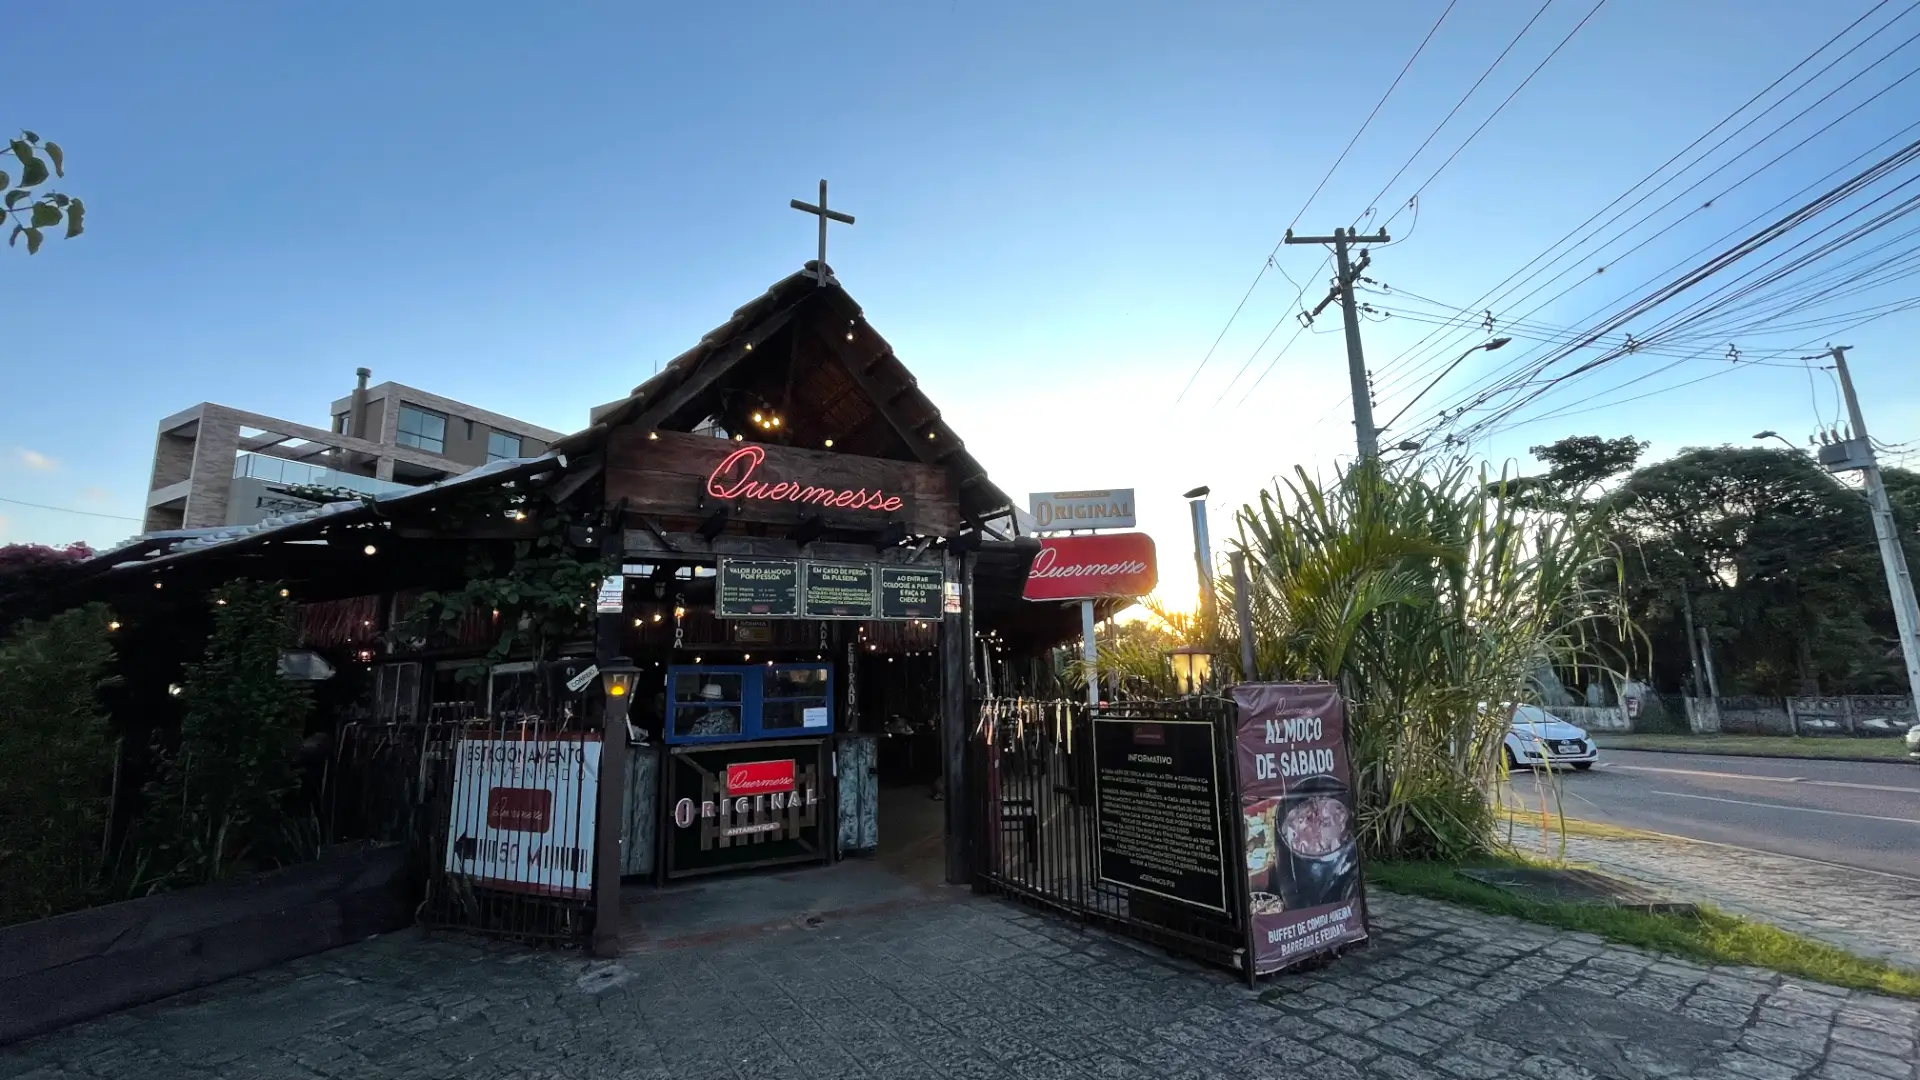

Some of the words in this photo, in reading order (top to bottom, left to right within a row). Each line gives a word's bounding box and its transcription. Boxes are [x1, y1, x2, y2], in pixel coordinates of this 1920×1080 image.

[708, 446, 904, 511] Quermesse
[1036, 501, 1132, 526] ORIGINAL
[1028, 547, 1147, 579] Quermesse
[570, 668, 597, 689] CORREIO
[1265, 717, 1322, 744] ALMOÇO
[468, 746, 585, 764] ESTACONAMENTO
[1127, 753, 1173, 765] INFORMATIVO
[1256, 753, 1277, 780] DE
[1280, 743, 1334, 777] SÁBADO
[730, 769, 794, 789] Quermesse
[675, 788, 817, 829] ORIGINAL
[727, 824, 775, 836] ANTARCTICA
[1268, 924, 1296, 944] BUFFET
[1297, 921, 1307, 936] DE
[1307, 913, 1328, 932] COMIDA
[1328, 905, 1353, 924] MINEIRA
[1314, 931, 1320, 945] E
